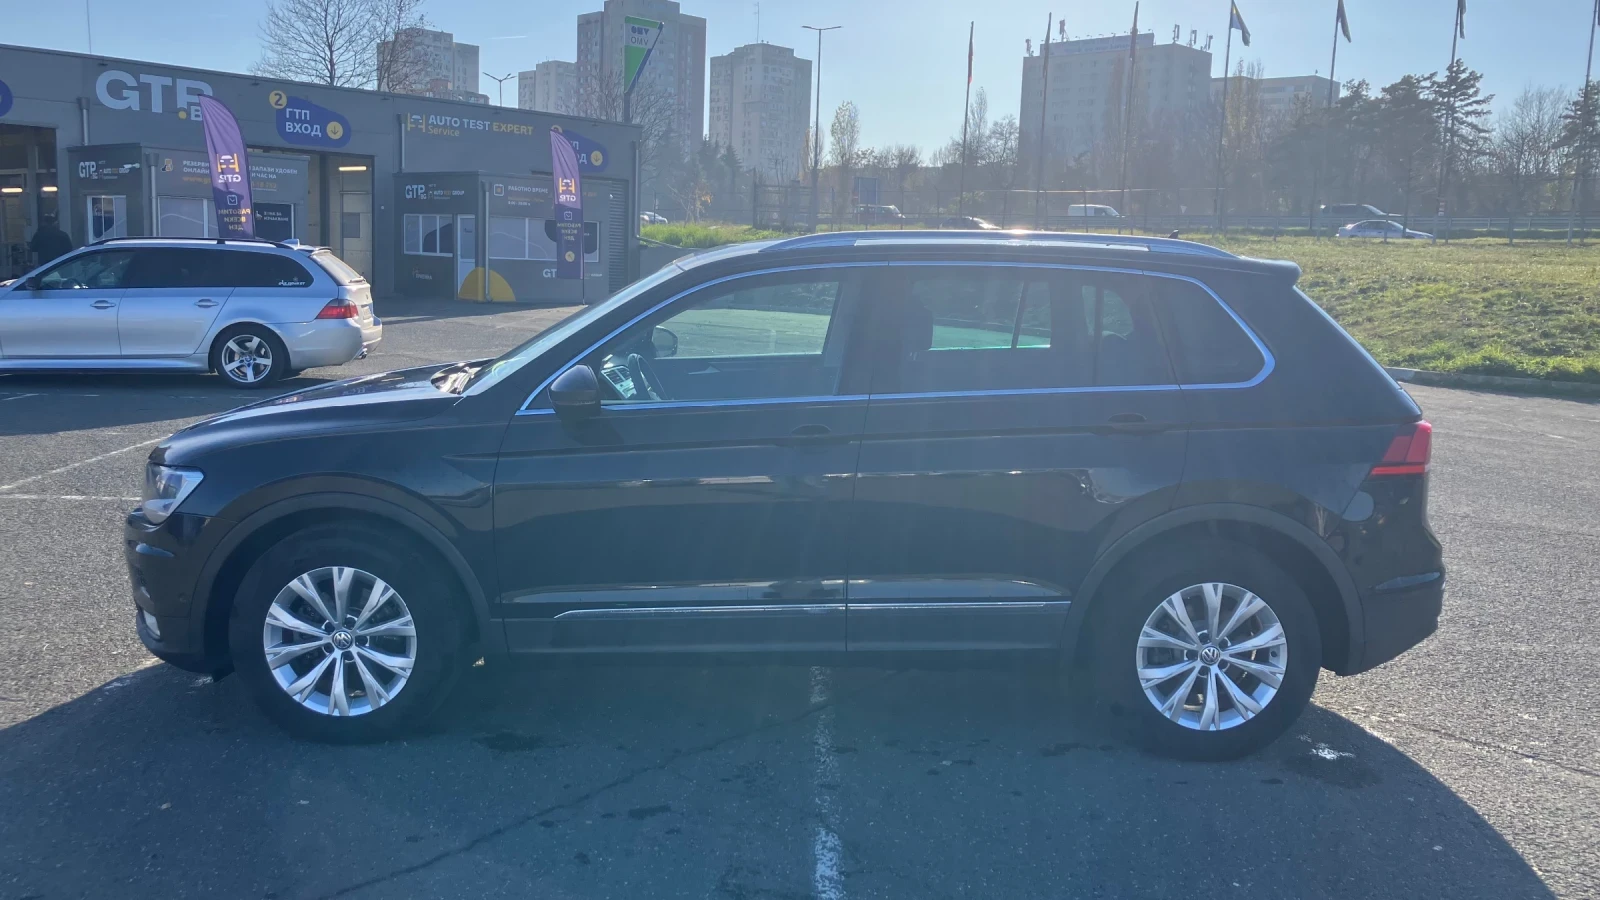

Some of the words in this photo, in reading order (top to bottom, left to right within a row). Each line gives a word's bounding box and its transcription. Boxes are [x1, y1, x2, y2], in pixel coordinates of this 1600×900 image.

[631, 36, 648, 46] OMV
[274, 93, 283, 106] 2
[286, 108, 310, 120] ГТП
[286, 122, 321, 137] ВХОД
[429, 115, 460, 127] AUTO
[463, 119, 490, 130] TEST
[493, 122, 533, 135] EXPERT
[428, 126, 460, 137] Service
[79, 161, 97, 178] GTP
[183, 160, 210, 168] РЕЗЕРВИ
[405, 184, 426, 199] GTP
[542, 268, 558, 279] GT
